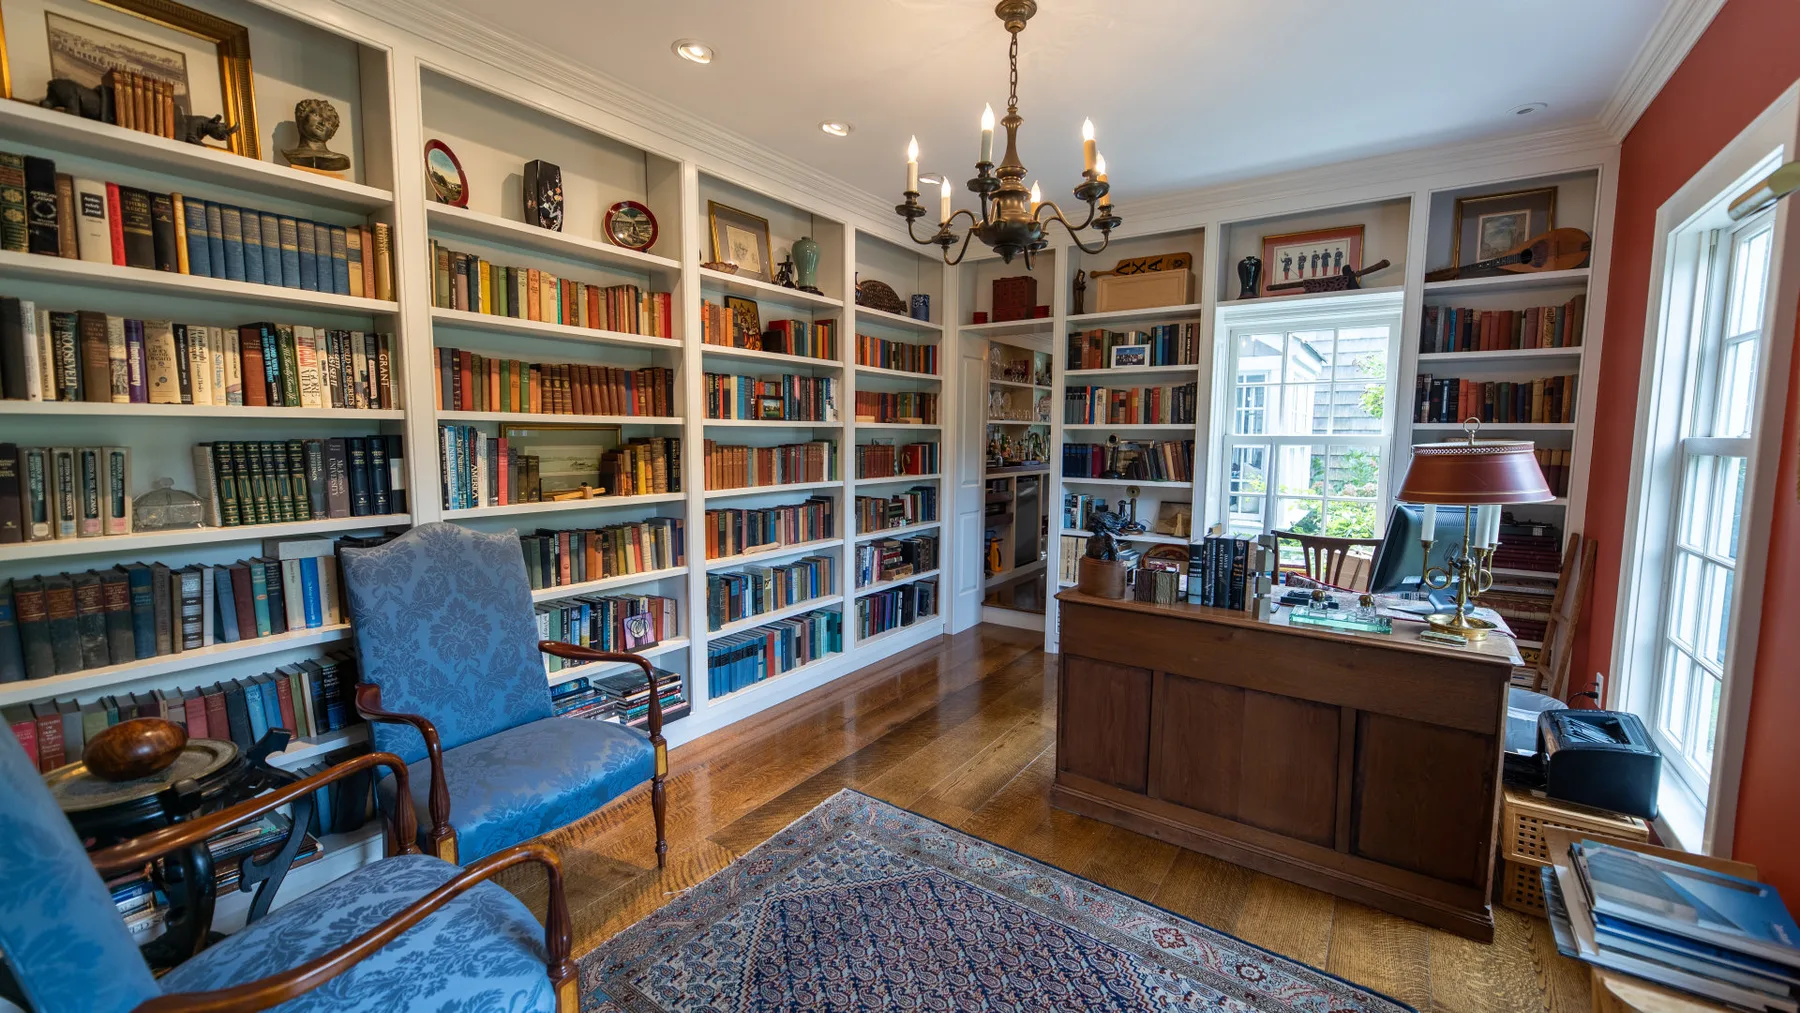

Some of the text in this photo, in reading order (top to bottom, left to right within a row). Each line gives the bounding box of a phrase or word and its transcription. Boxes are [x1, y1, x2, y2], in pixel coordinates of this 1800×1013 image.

[60, 330, 78, 389] ROOSEVELT
[128, 341, 142, 387] Montgomery
[297, 335, 317, 369] LINCOLN
[328, 353, 336, 363] AS
[343, 339, 351, 364] WORLD
[300, 369, 312, 397] VIDAL
[309, 368, 321, 397] GORE
[330, 379, 338, 387] IT
[345, 365, 352, 375] OF
[379, 354, 389, 388] GRANT
[346, 376, 355, 406] SECRETS
[329, 457, 339, 497] UNIVERSITY
[337, 469, 345, 495] Jefferson's
[450, 469, 458, 497] HERITAGE
[471, 464, 479, 499] AMERICA
